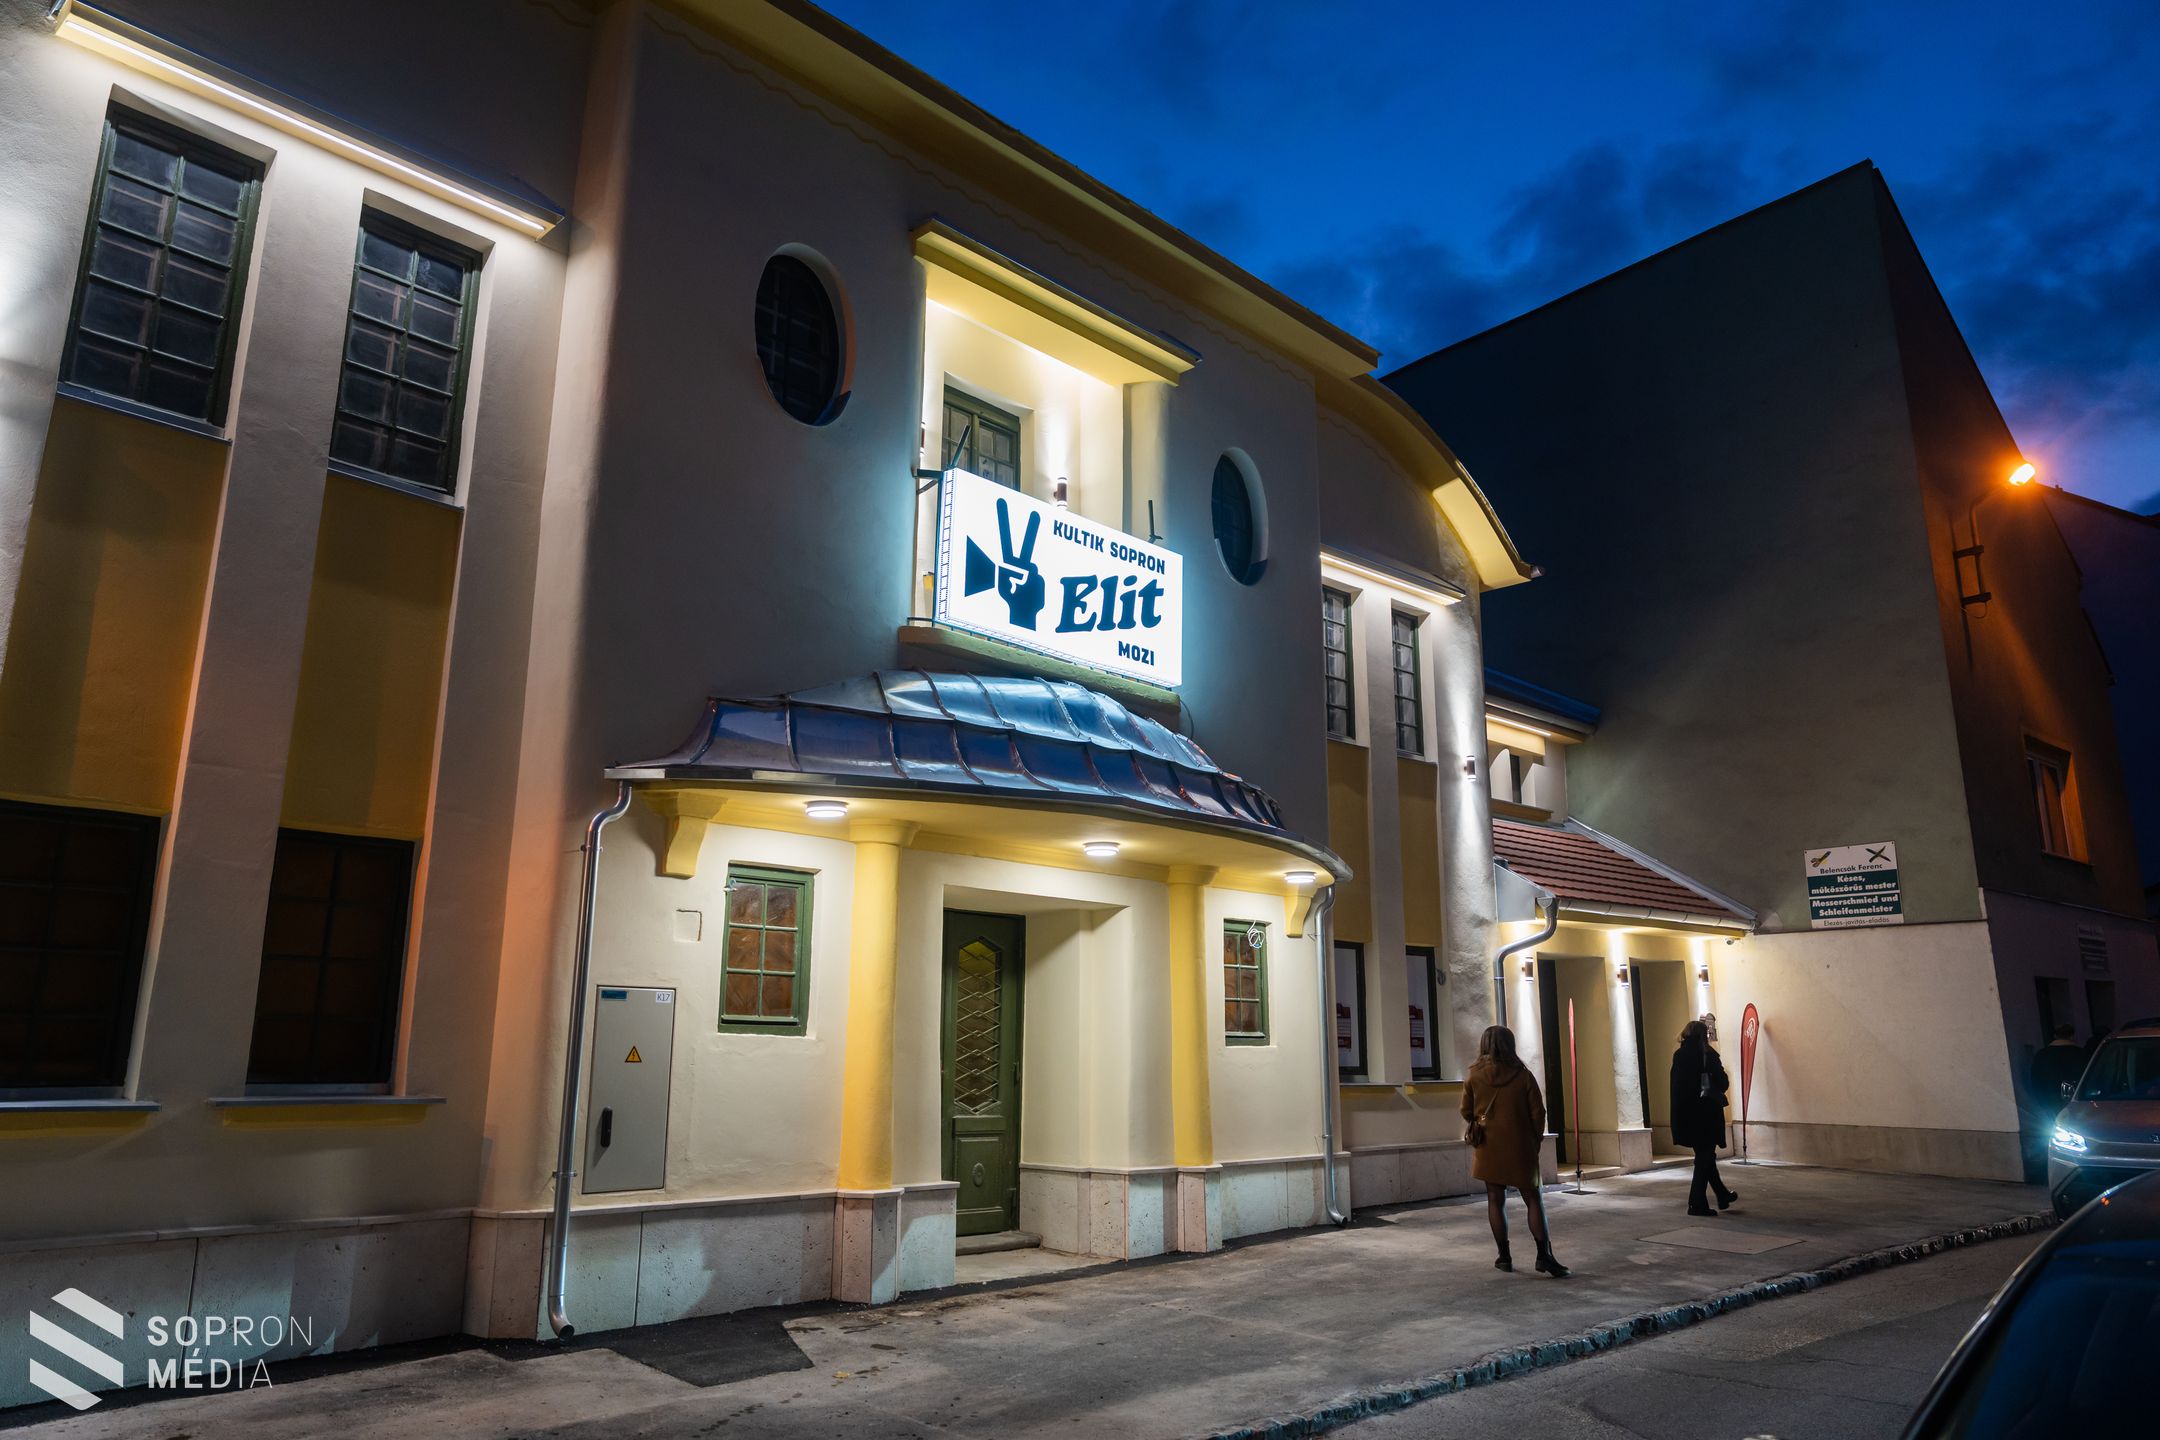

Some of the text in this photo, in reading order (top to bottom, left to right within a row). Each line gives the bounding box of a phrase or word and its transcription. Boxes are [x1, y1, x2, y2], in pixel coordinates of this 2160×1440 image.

[1053, 519, 1165, 575] KULTIK SOPRON
[1055, 574, 1164, 634] Elit
[1118, 640, 1155, 666] MOZI
[1865, 882, 1896, 890] mester
[1812, 894, 1898, 907] Messerschmied und
[1819, 905, 1893, 916] Schleifenmeister
